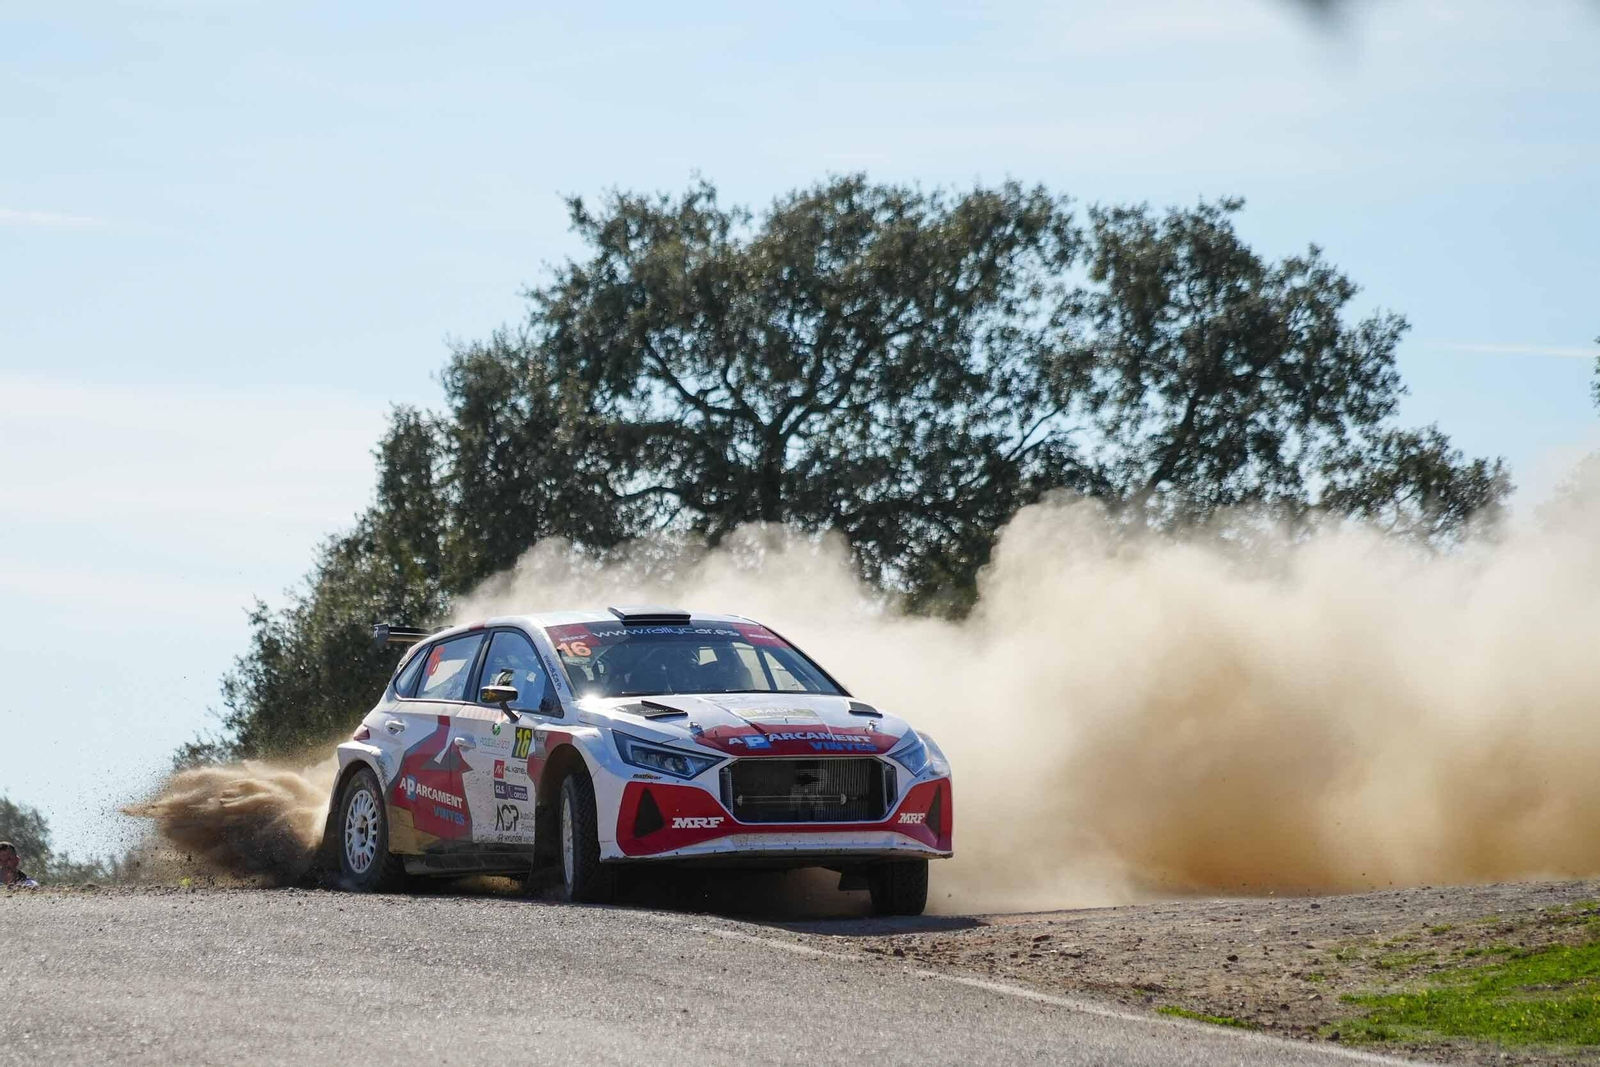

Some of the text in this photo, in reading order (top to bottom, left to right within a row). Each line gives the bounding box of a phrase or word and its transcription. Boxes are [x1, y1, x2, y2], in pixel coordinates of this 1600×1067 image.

[557, 641, 592, 657] 16
[516, 728, 531, 758] 16
[399, 776, 463, 809] APARCAMENT
[671, 817, 724, 828] MRF
[898, 812, 926, 824] MRF
